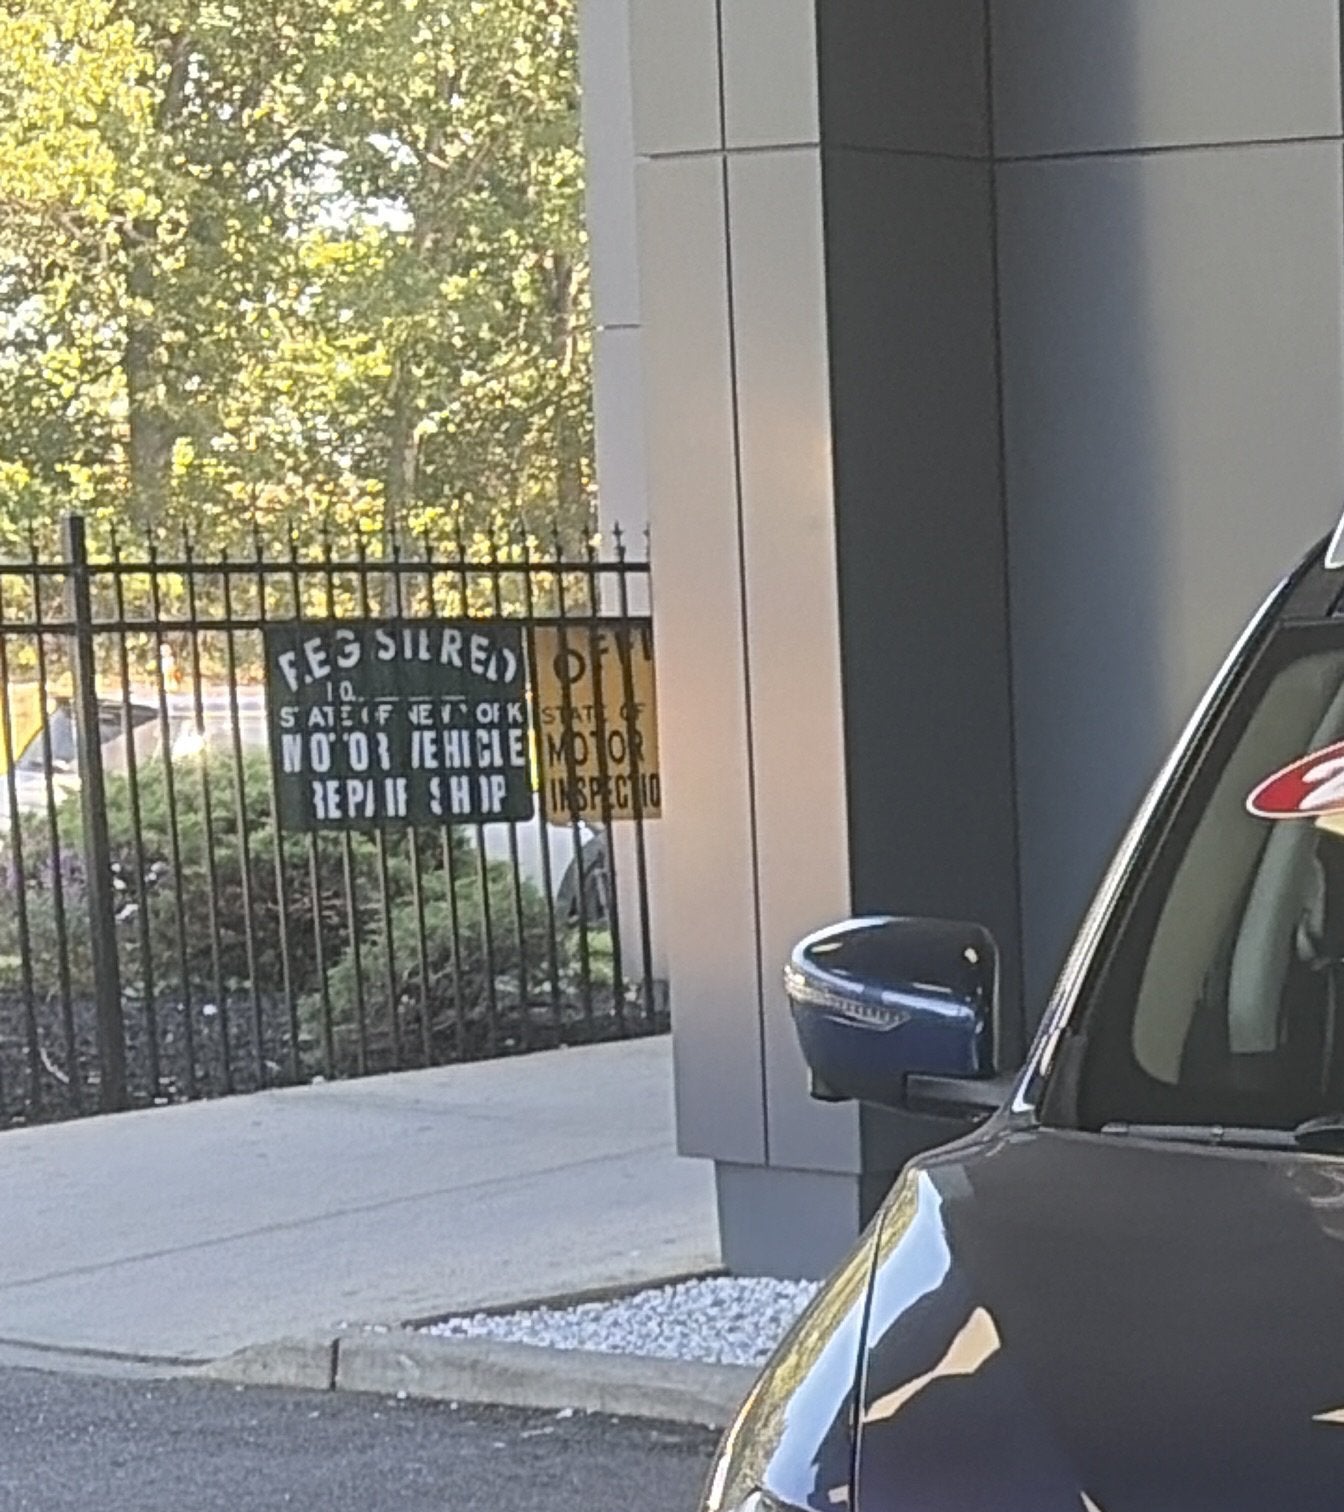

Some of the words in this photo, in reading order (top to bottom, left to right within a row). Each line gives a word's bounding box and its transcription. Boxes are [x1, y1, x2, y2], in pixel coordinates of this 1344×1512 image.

[279, 627, 517, 692] REGSTERED
[279, 703, 353, 728] SATE
[541, 704, 607, 724] SAT
[280, 732, 392, 774] MOOR
[547, 729, 645, 768] MOOR
